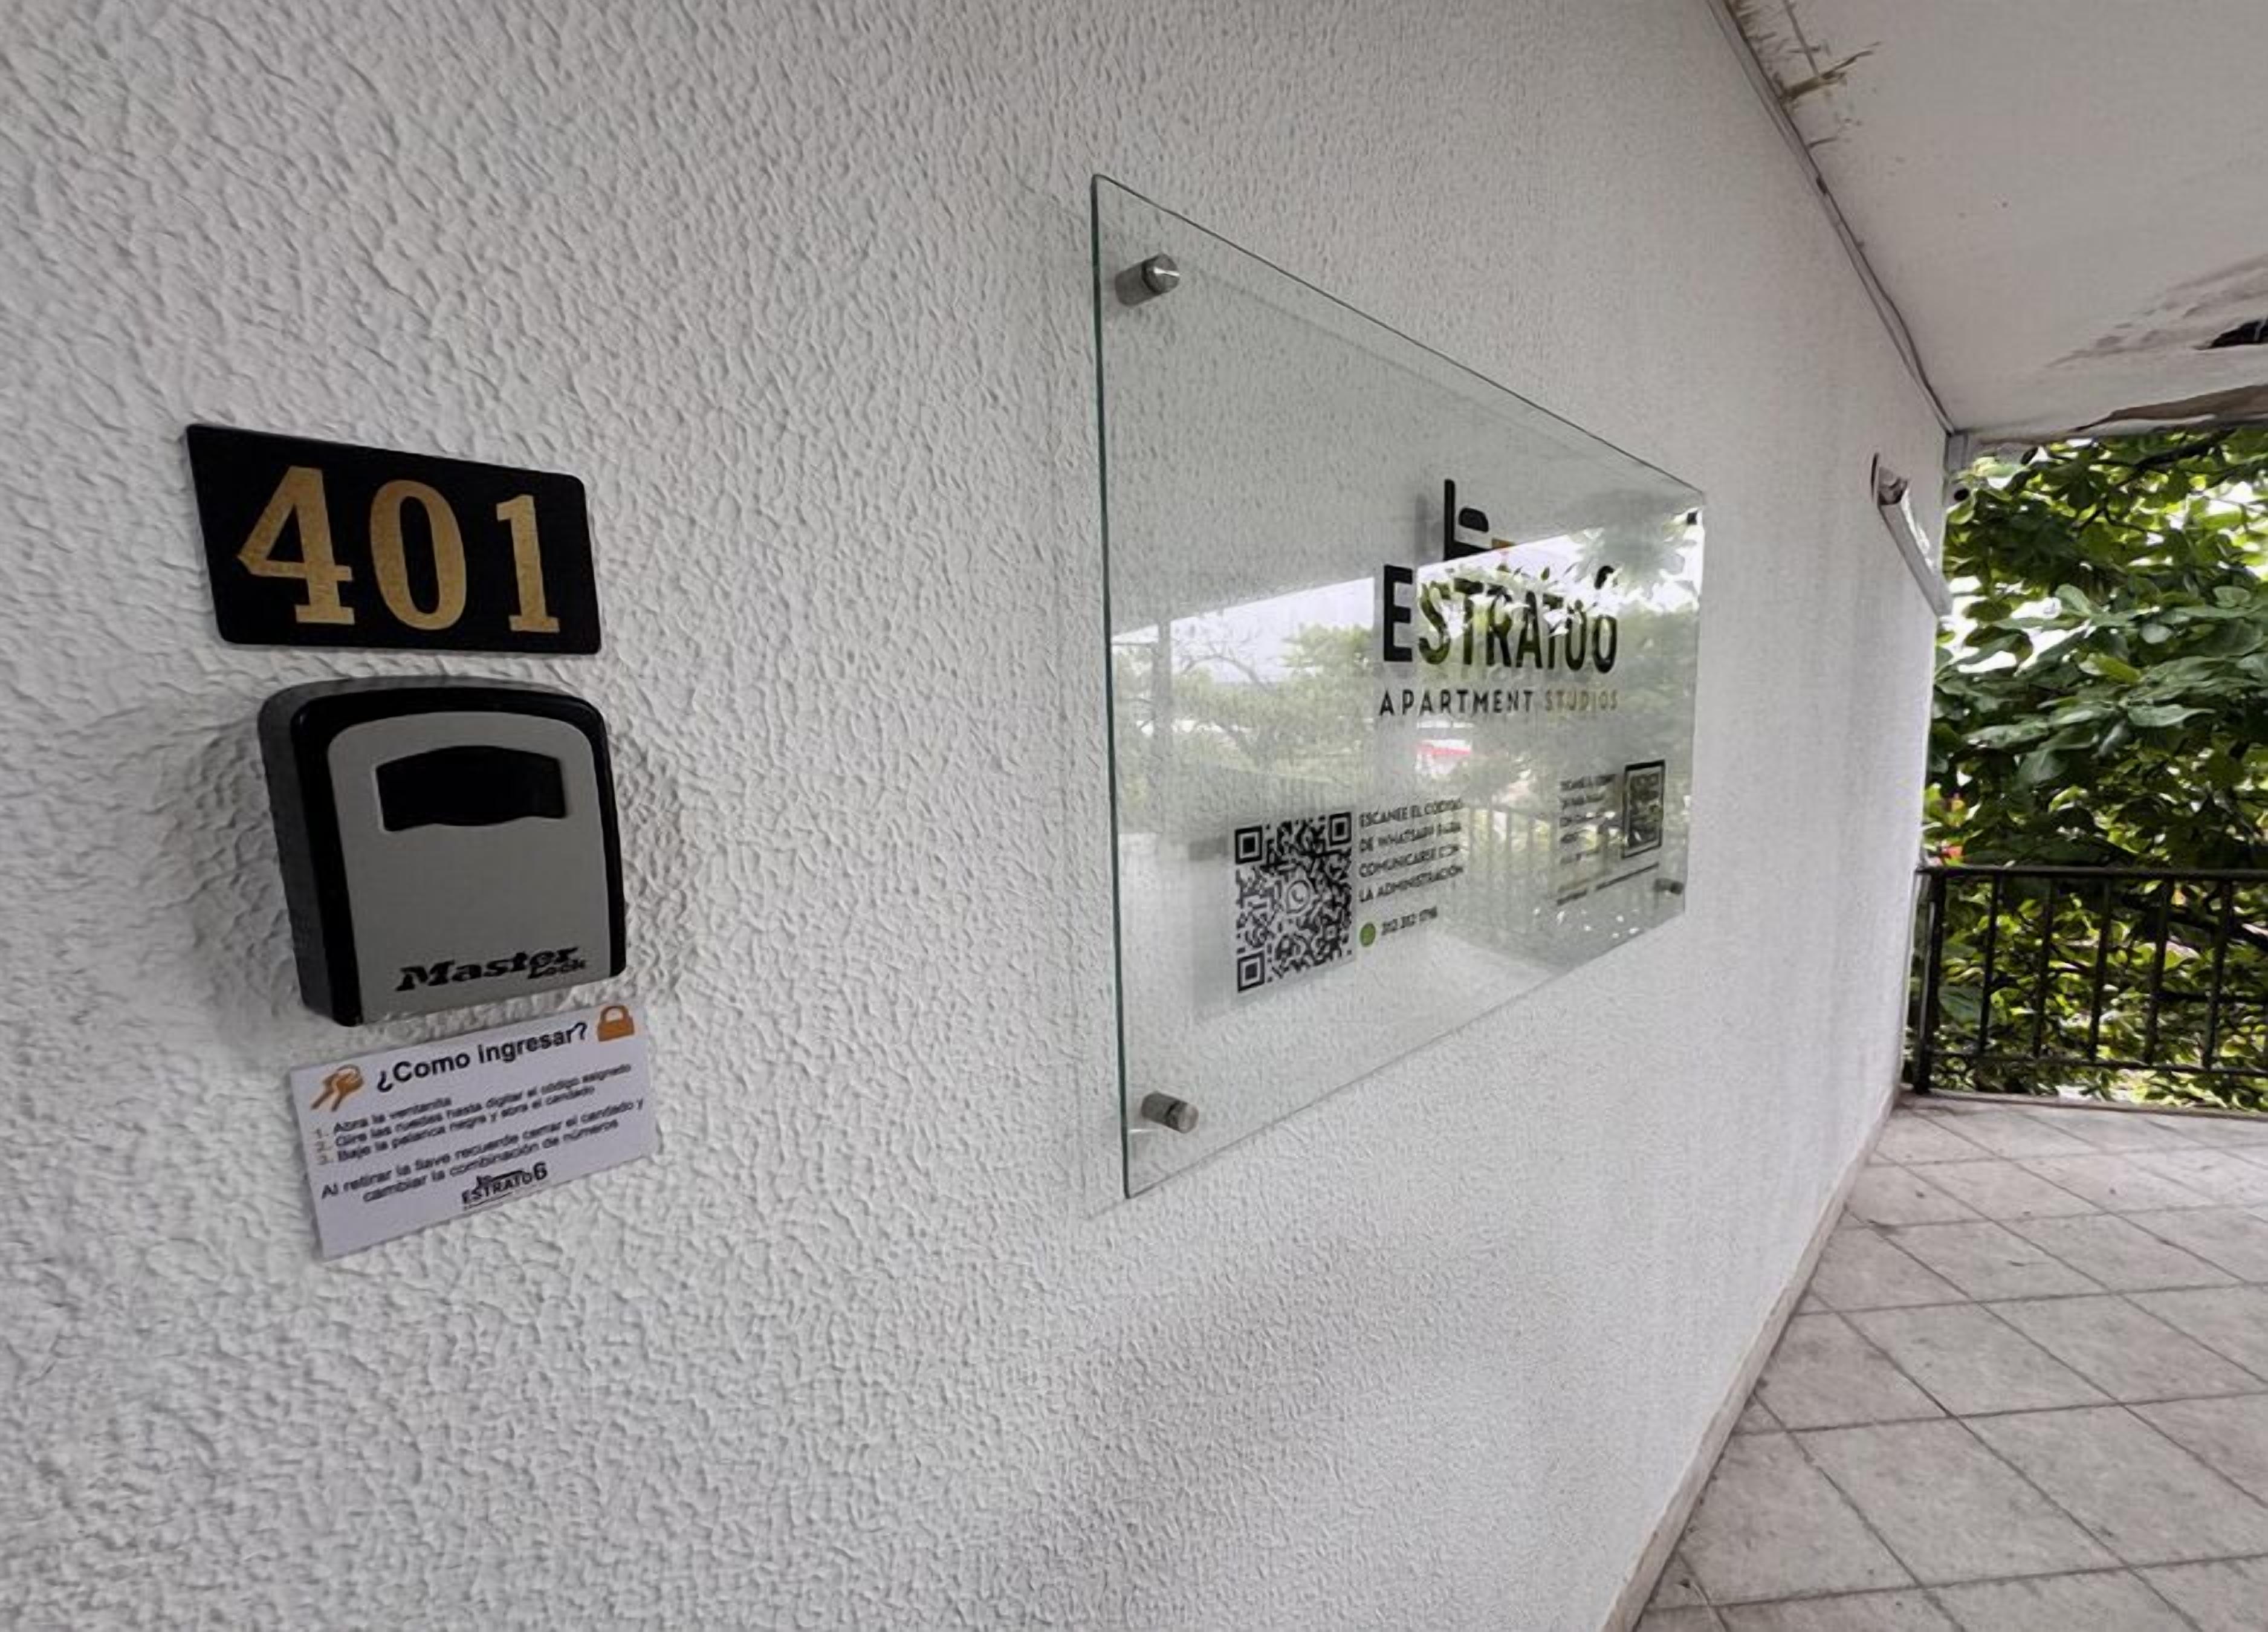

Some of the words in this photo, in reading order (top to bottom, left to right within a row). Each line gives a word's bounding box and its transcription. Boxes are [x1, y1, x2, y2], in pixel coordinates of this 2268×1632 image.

[237, 465, 560, 633] 401
[1379, 688, 1534, 717] APARTMENT
[1545, 688, 1618, 713] STUDIOS
[395, 947, 578, 991] Master
[377, 1052, 471, 1092] ¿Como
[322, 1182, 339, 1200] Al
